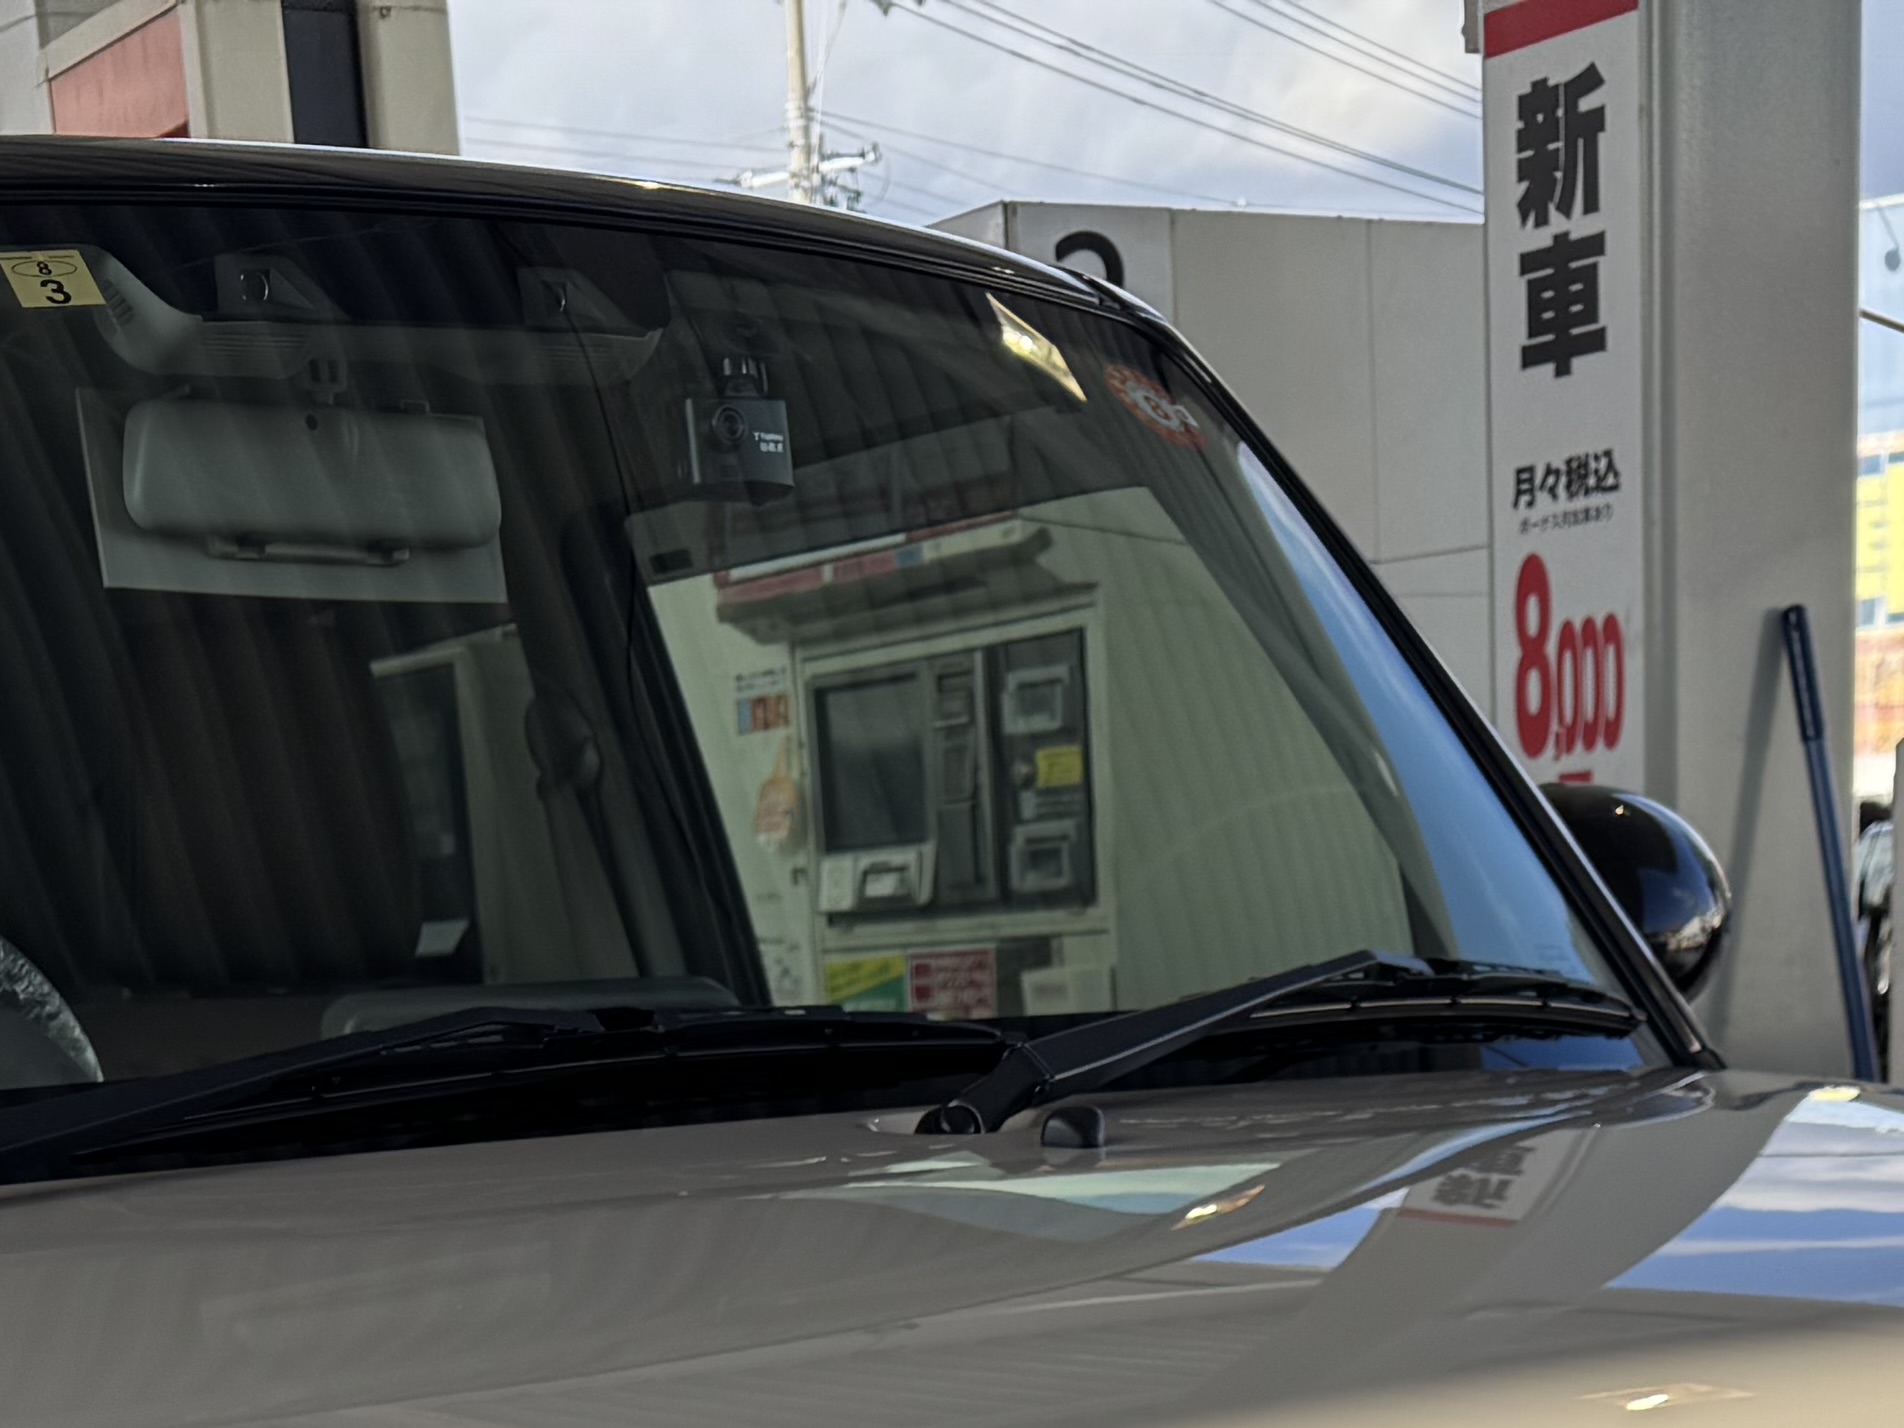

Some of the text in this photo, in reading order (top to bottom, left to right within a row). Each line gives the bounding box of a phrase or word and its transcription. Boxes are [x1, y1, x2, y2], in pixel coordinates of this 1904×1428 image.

[1514, 62, 1608, 378] 新車
[36, 261, 52, 275] 8
[40, 279, 72, 304] 3
[1512, 449, 1620, 510] 月々税込
[1515, 552, 1625, 761] 8,000
